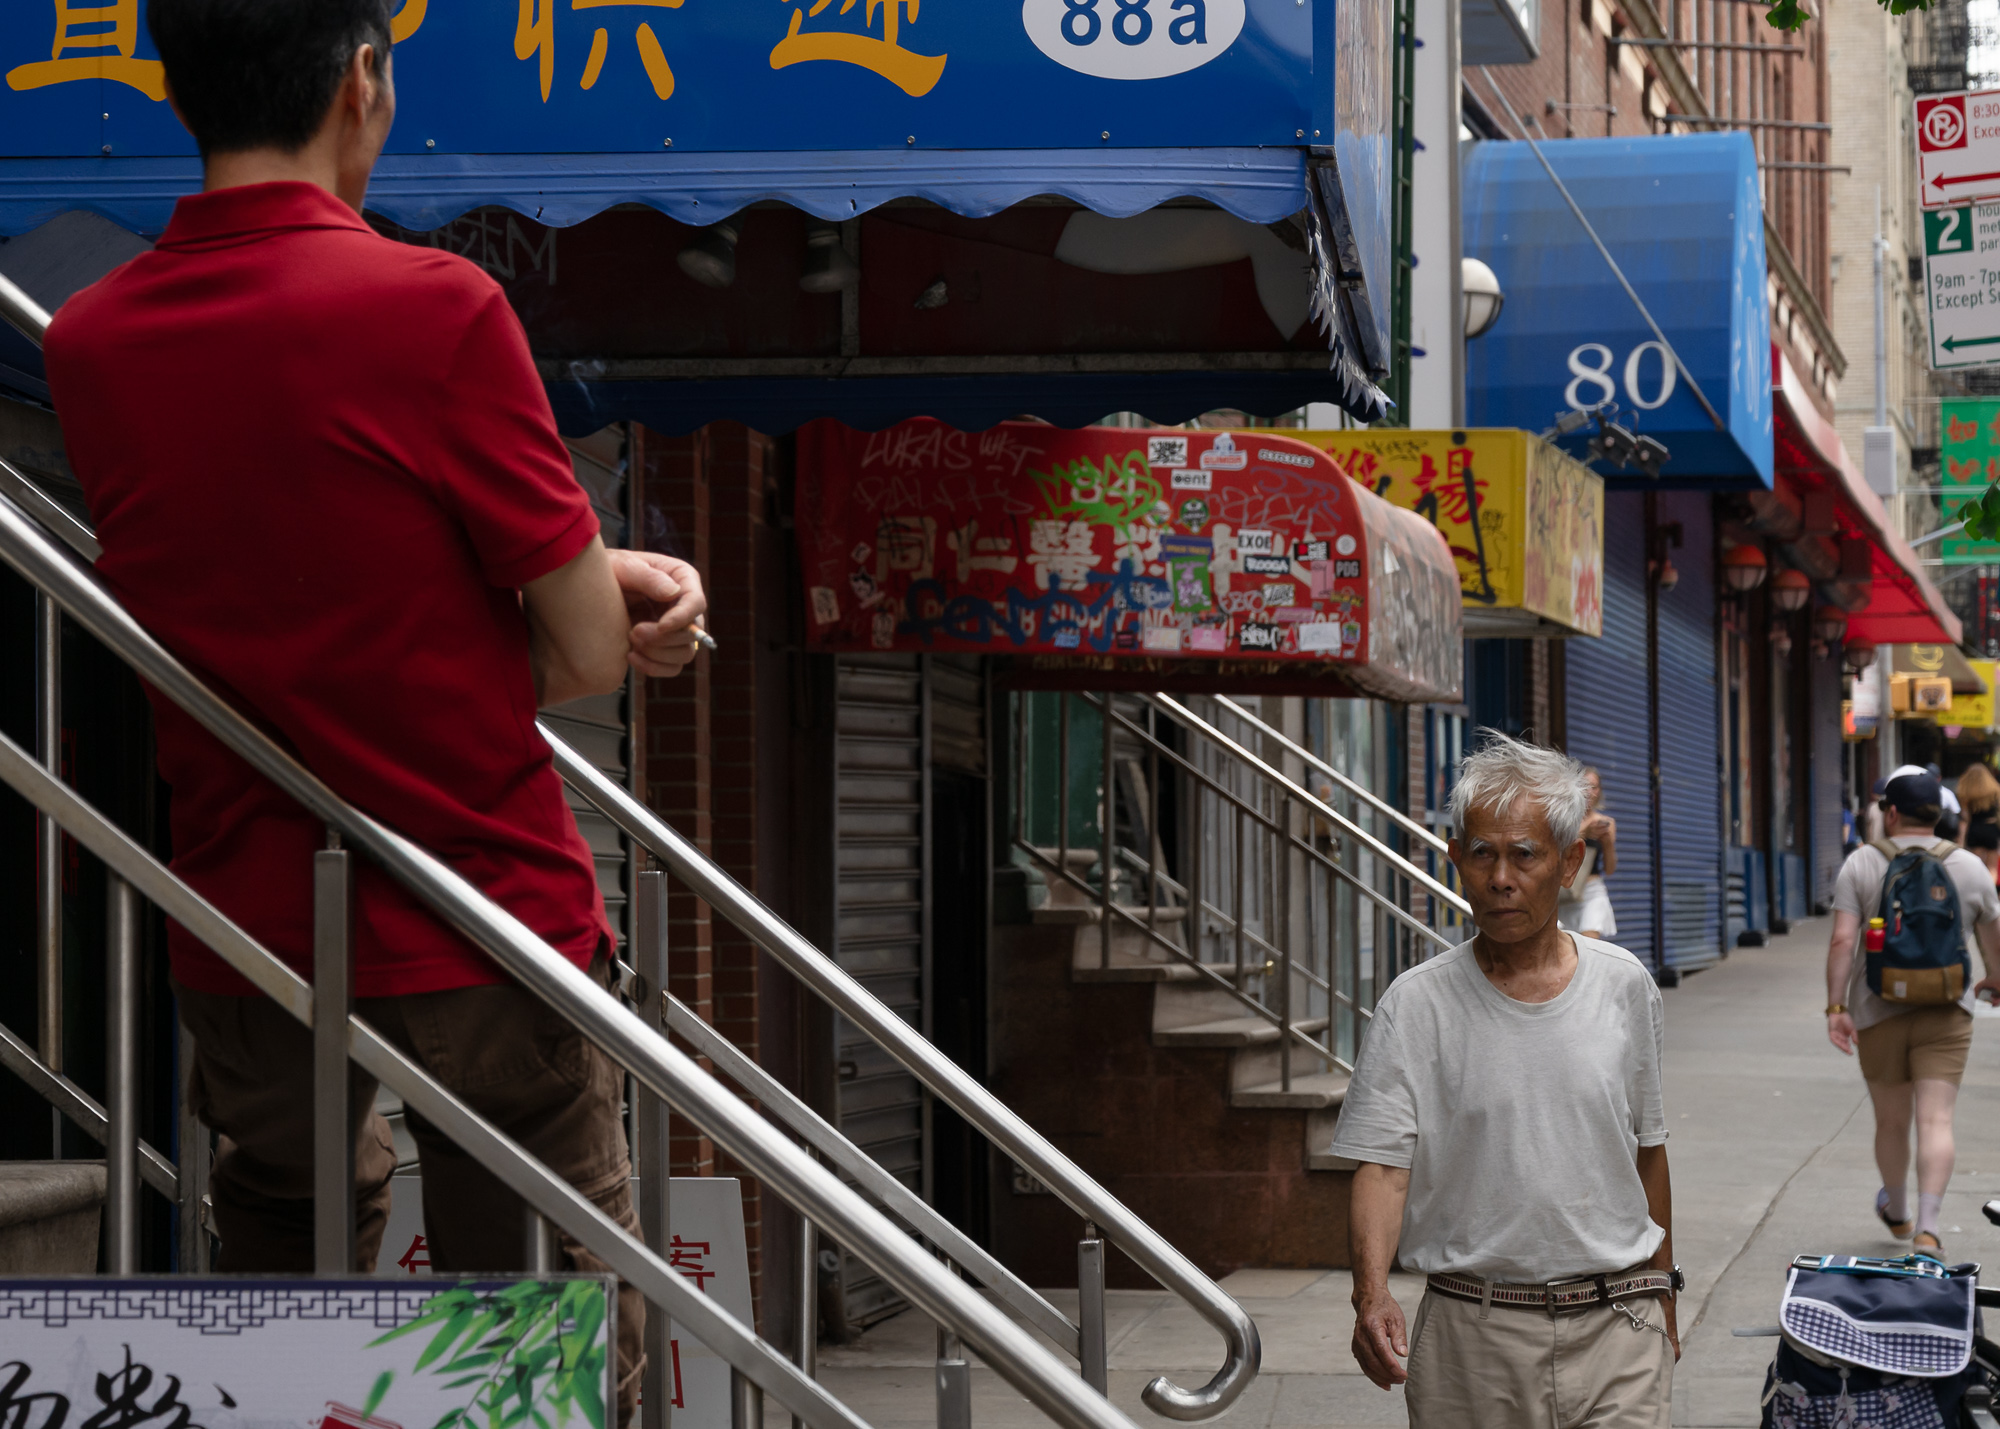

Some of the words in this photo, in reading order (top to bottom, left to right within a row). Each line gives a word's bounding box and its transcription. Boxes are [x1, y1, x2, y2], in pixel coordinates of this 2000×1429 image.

[1061, 0, 1207, 46] 88a
[1936, 209, 1962, 251] 2
[1935, 273, 1965, 289] 9am
[1980, 268, 2000, 286] 7p
[1936, 289, 1984, 310] Except
[1564, 341, 1677, 411] 80
